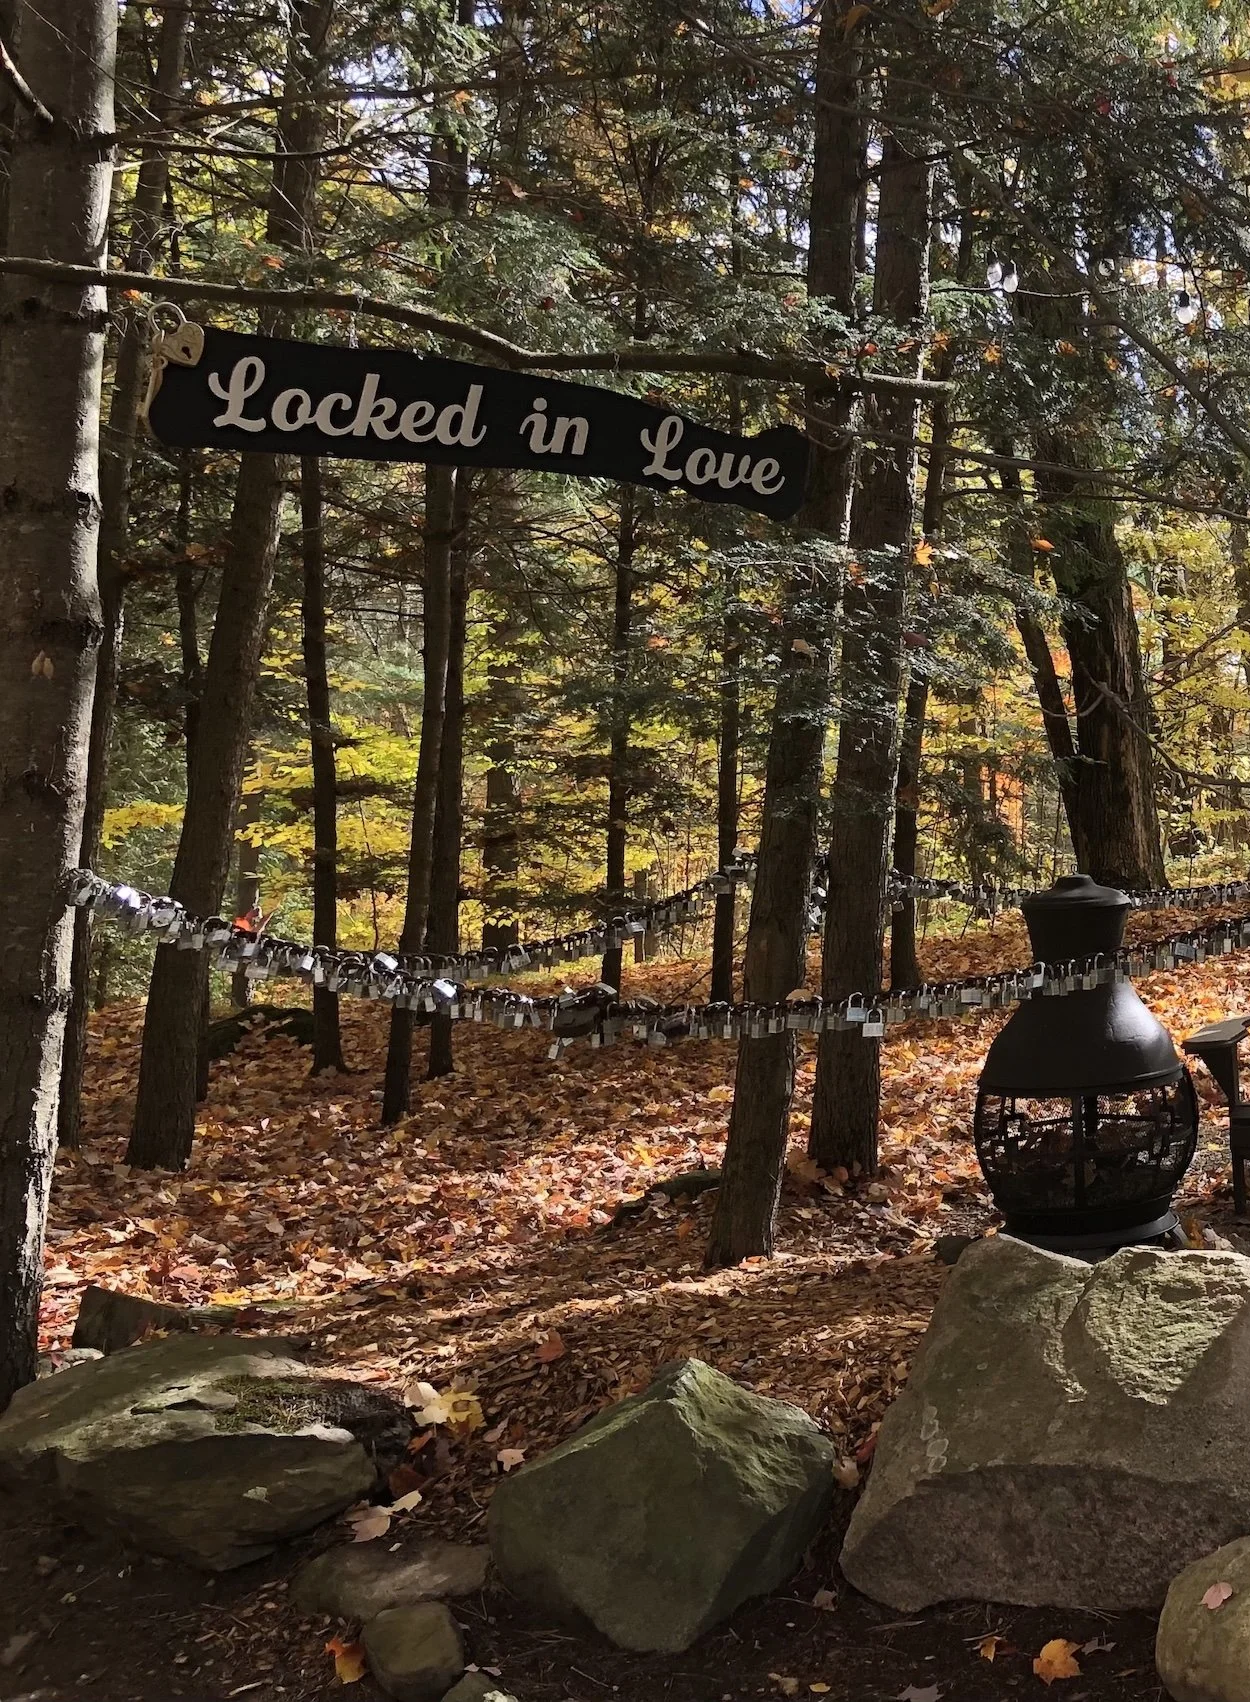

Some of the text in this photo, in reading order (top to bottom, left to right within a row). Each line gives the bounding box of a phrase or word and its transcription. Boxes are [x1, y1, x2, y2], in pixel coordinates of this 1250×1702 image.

[208, 356, 785, 496] Locked in Love
